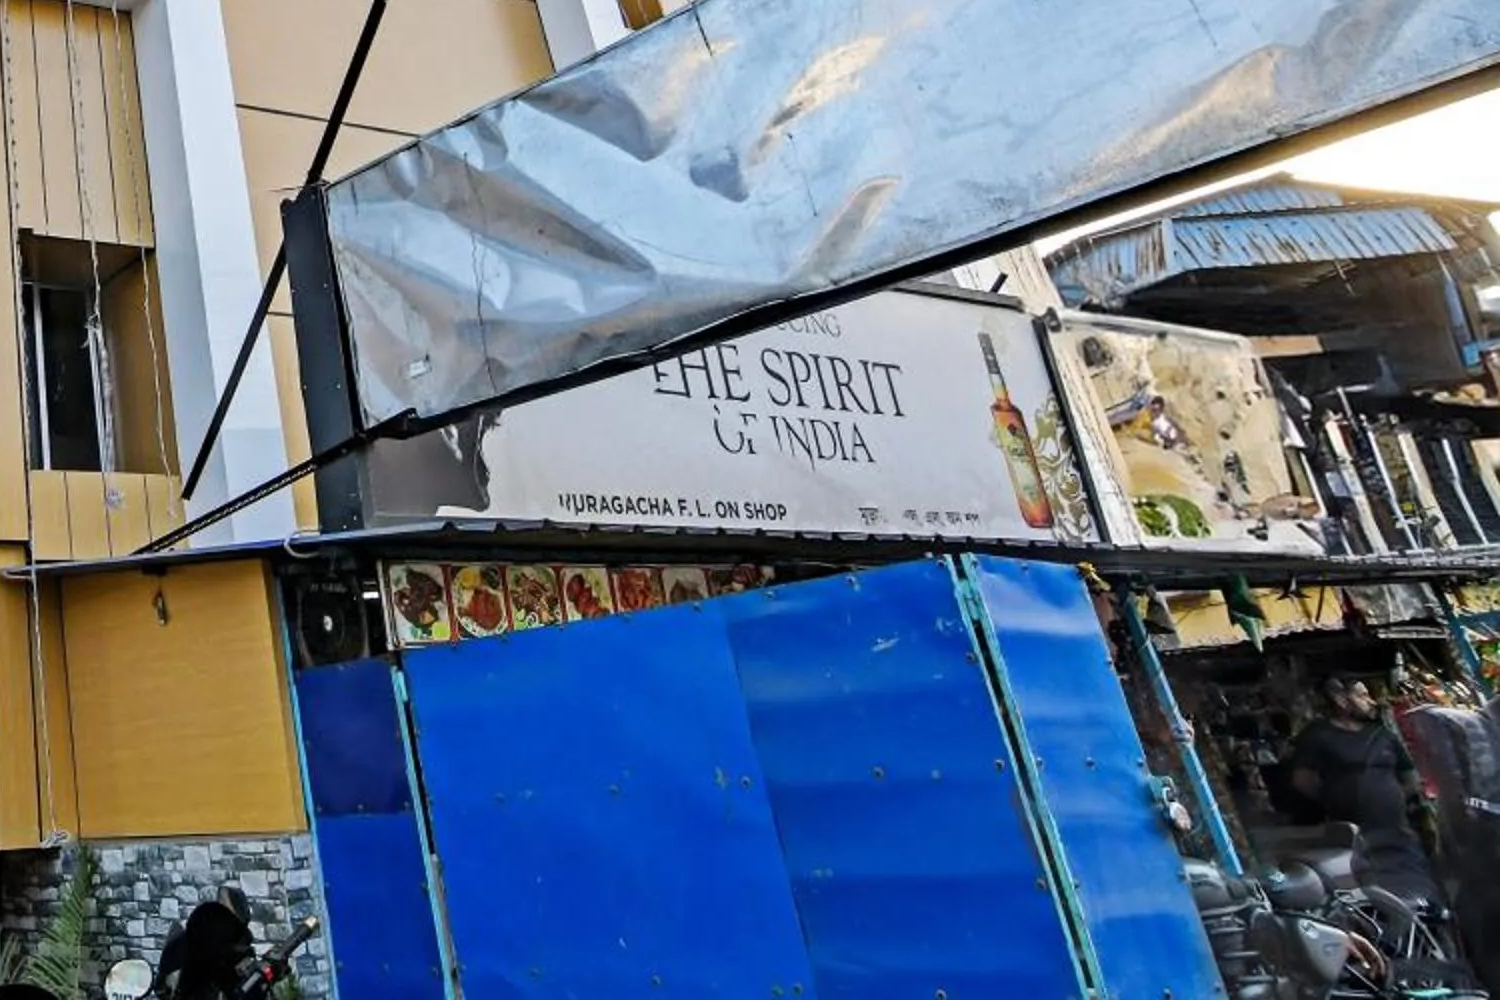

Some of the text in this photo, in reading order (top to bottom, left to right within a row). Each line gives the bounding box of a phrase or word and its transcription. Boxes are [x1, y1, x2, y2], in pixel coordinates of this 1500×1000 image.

[760, 347, 904, 417] SPIRIT
[768, 415, 876, 470] INDIA
[678, 498, 693, 517] F.
[697, 499, 711, 518] L.
[715, 501, 740, 519] ON
[743, 502, 788, 521] SHOP
